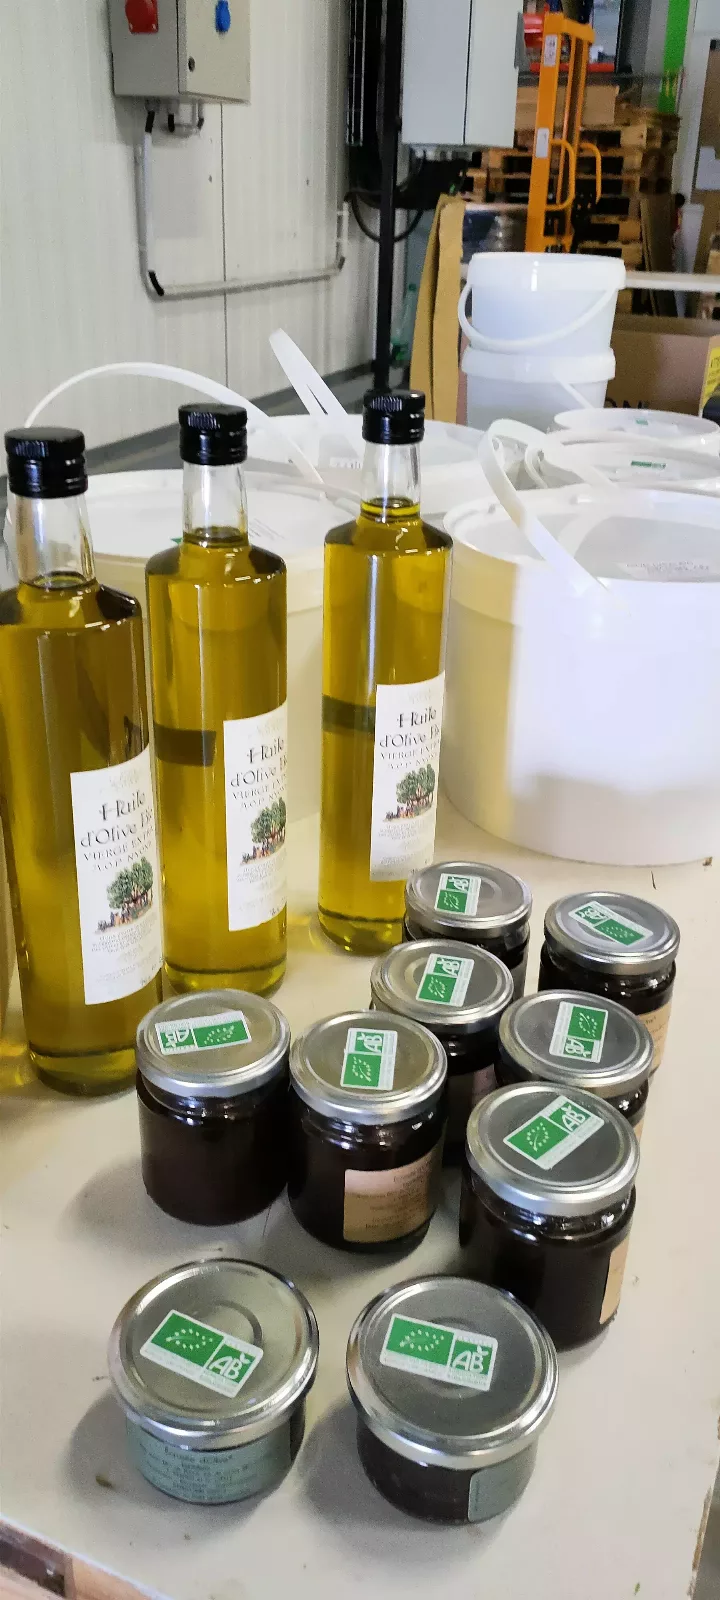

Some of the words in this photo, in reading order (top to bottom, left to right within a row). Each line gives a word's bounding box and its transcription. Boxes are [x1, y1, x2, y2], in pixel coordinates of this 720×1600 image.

[396, 706, 437, 728] Huile
[246, 737, 284, 764] Huile
[379, 733, 426, 748] d'Olive
[230, 768, 277, 788] d'Olive
[99, 790, 145, 821] Huile
[80, 825, 137, 847] d'Olive
[453, 879, 469, 891] AB
[442, 960, 460, 976] AB
[166, 1029, 190, 1044] AB
[363, 1035, 383, 1053] AB
[565, 1037, 584, 1054] AB
[562, 1110, 586, 1132] AB
[208, 1355, 243, 1380] AB
[451, 1350, 484, 1373] AB
